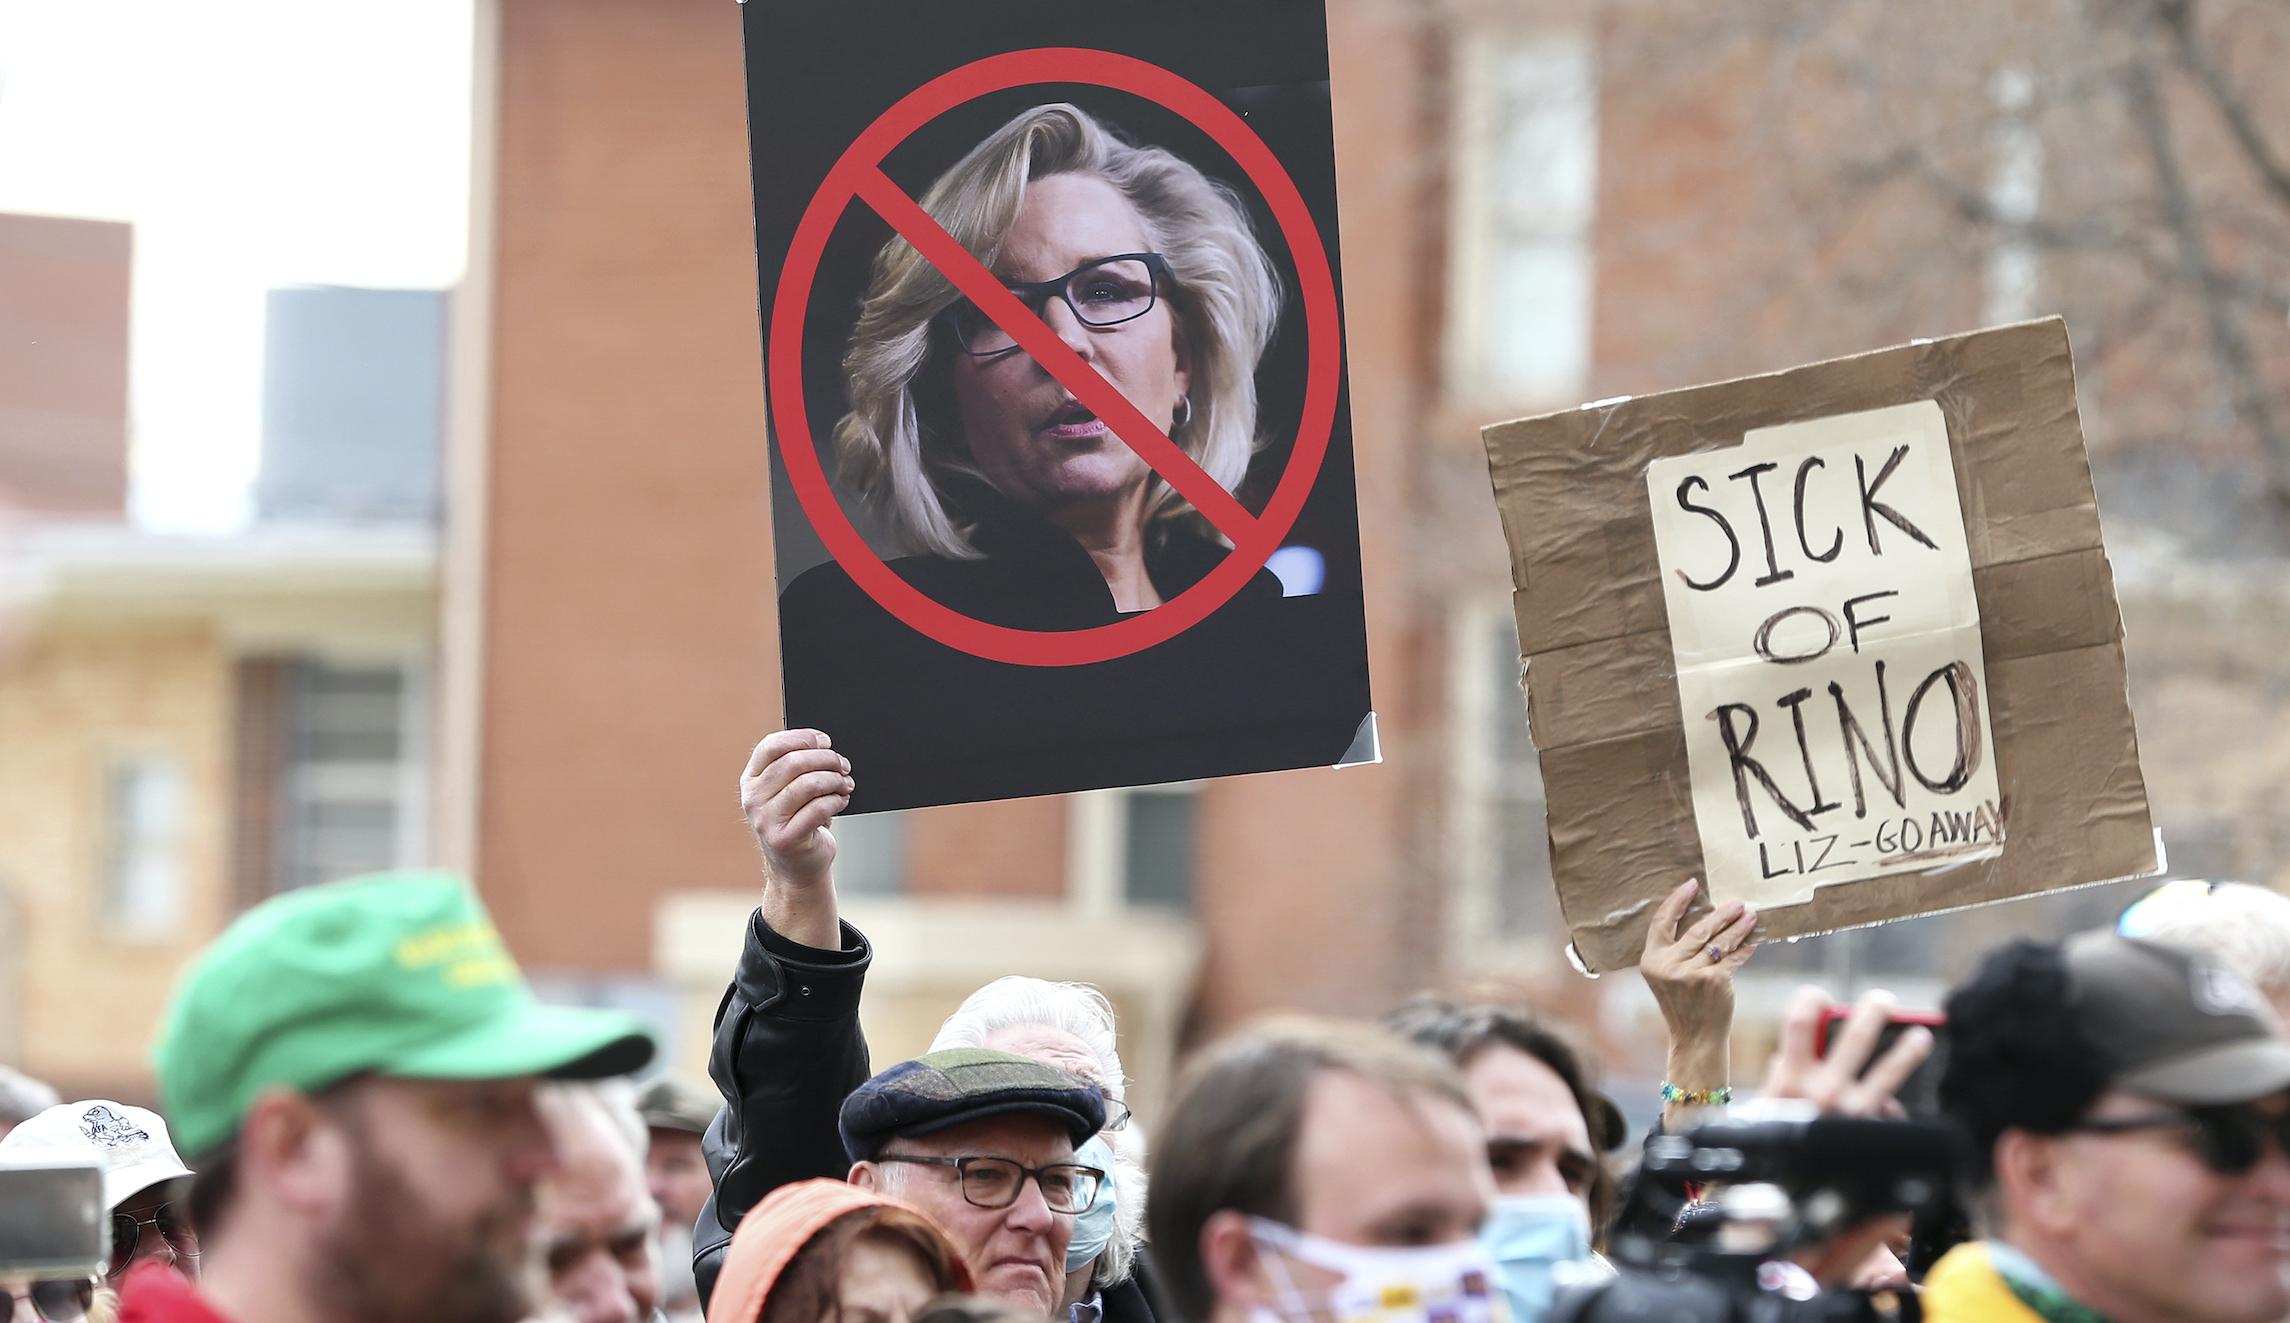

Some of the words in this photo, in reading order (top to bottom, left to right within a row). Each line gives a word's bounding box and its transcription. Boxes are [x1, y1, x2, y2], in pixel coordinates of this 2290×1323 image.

[1676, 444, 1939, 591] SICK
[1754, 590, 1899, 663] OF
[1706, 660, 1982, 838] RINO
